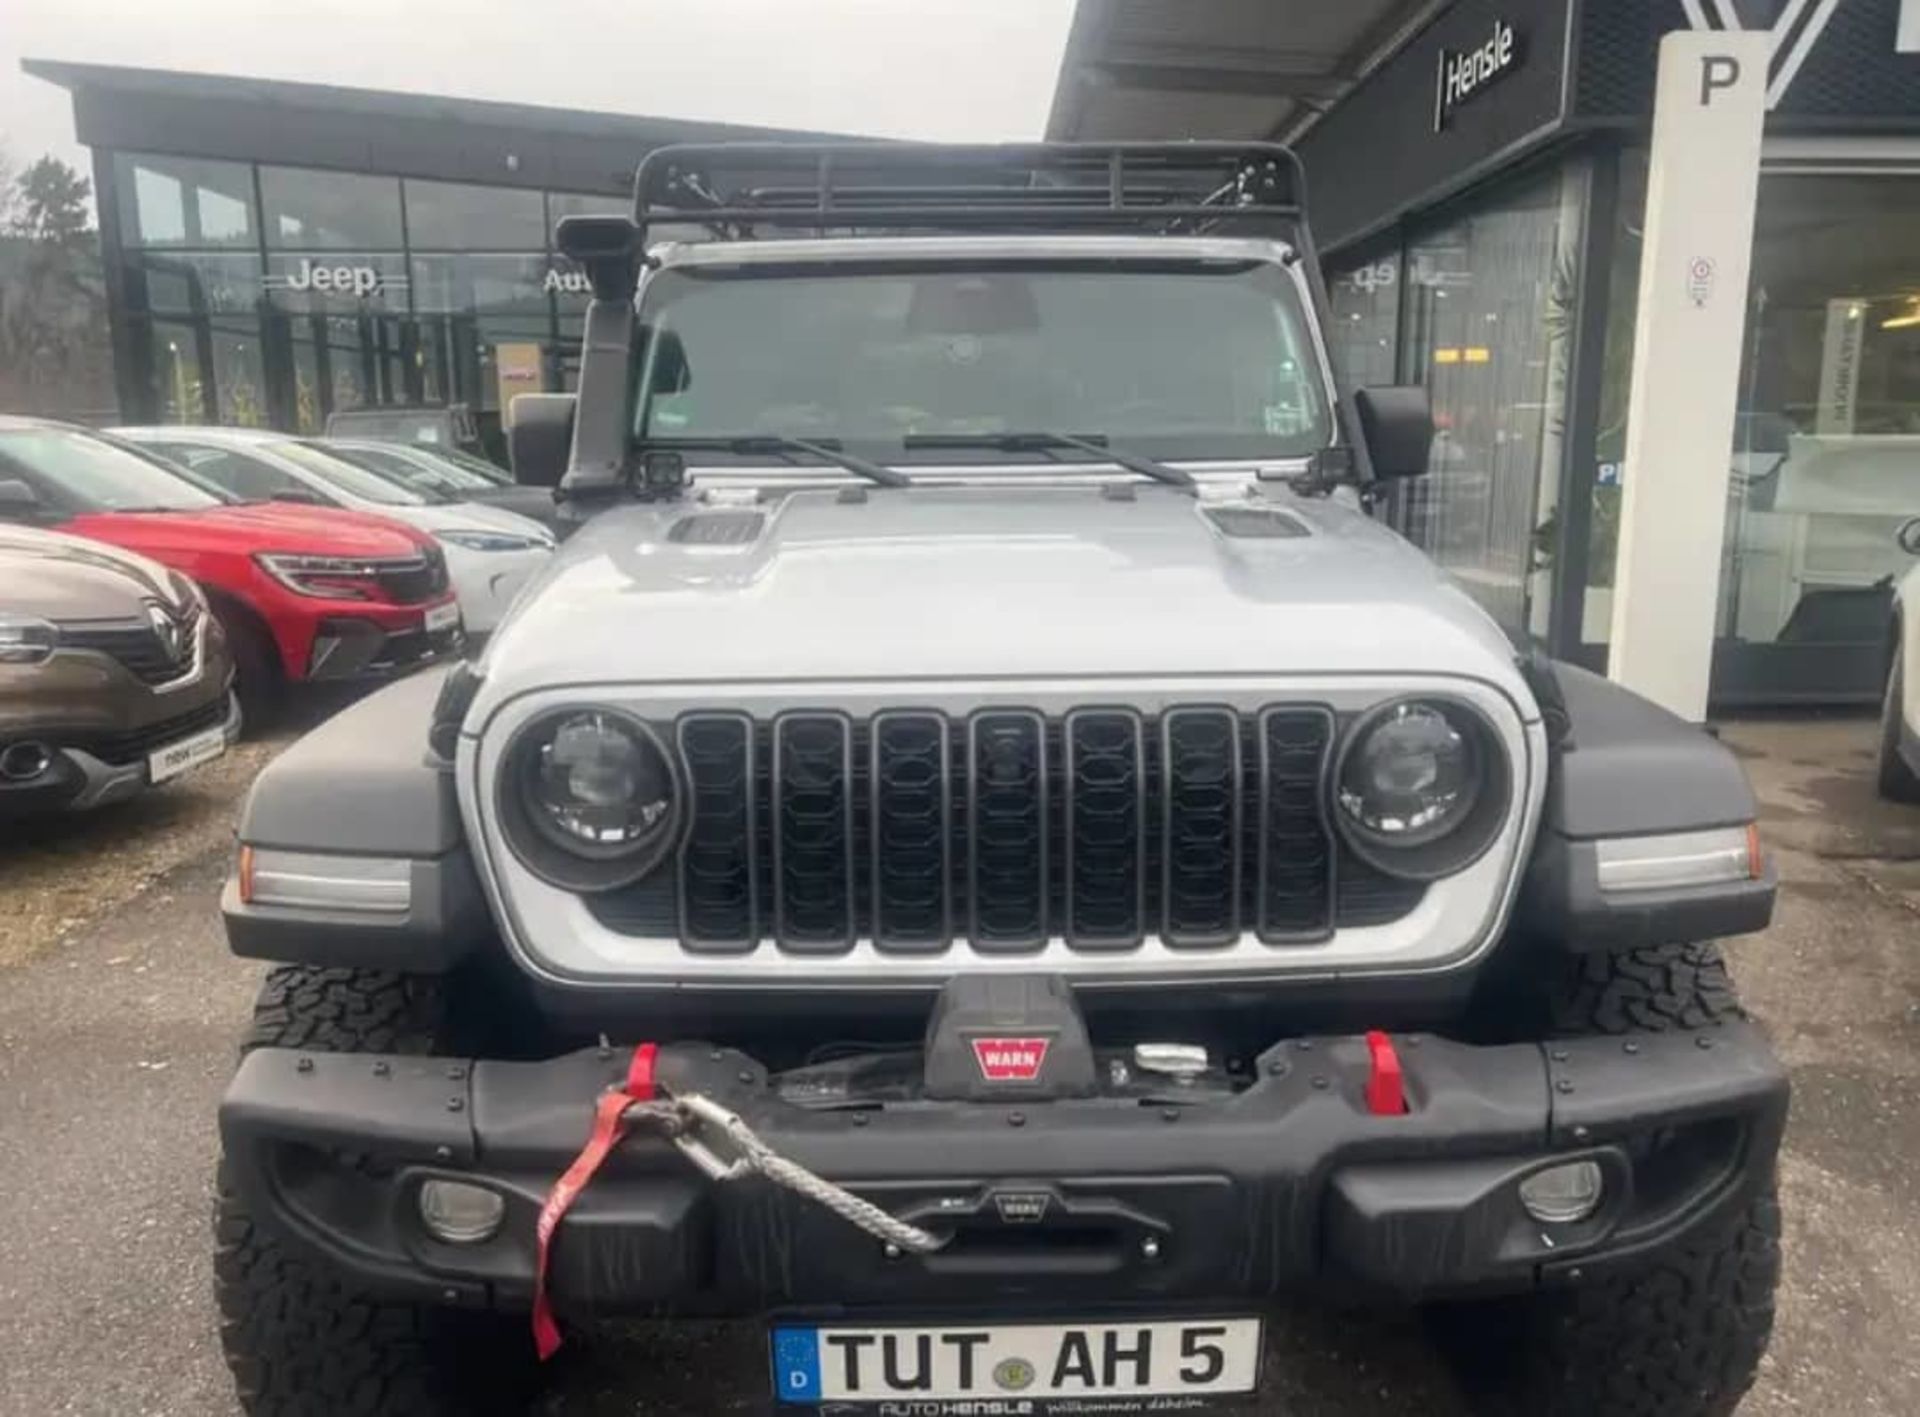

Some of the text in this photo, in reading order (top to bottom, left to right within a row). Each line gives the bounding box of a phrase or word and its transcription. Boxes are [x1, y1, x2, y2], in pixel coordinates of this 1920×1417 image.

[1446, 20, 1513, 105] Hensle
[1700, 55, 1741, 107] P
[287, 257, 377, 297] Jeep
[984, 1051, 1037, 1068] WARN
[790, 1371, 808, 1389] D
[826, 1326, 1227, 1392] TUT AH 5
